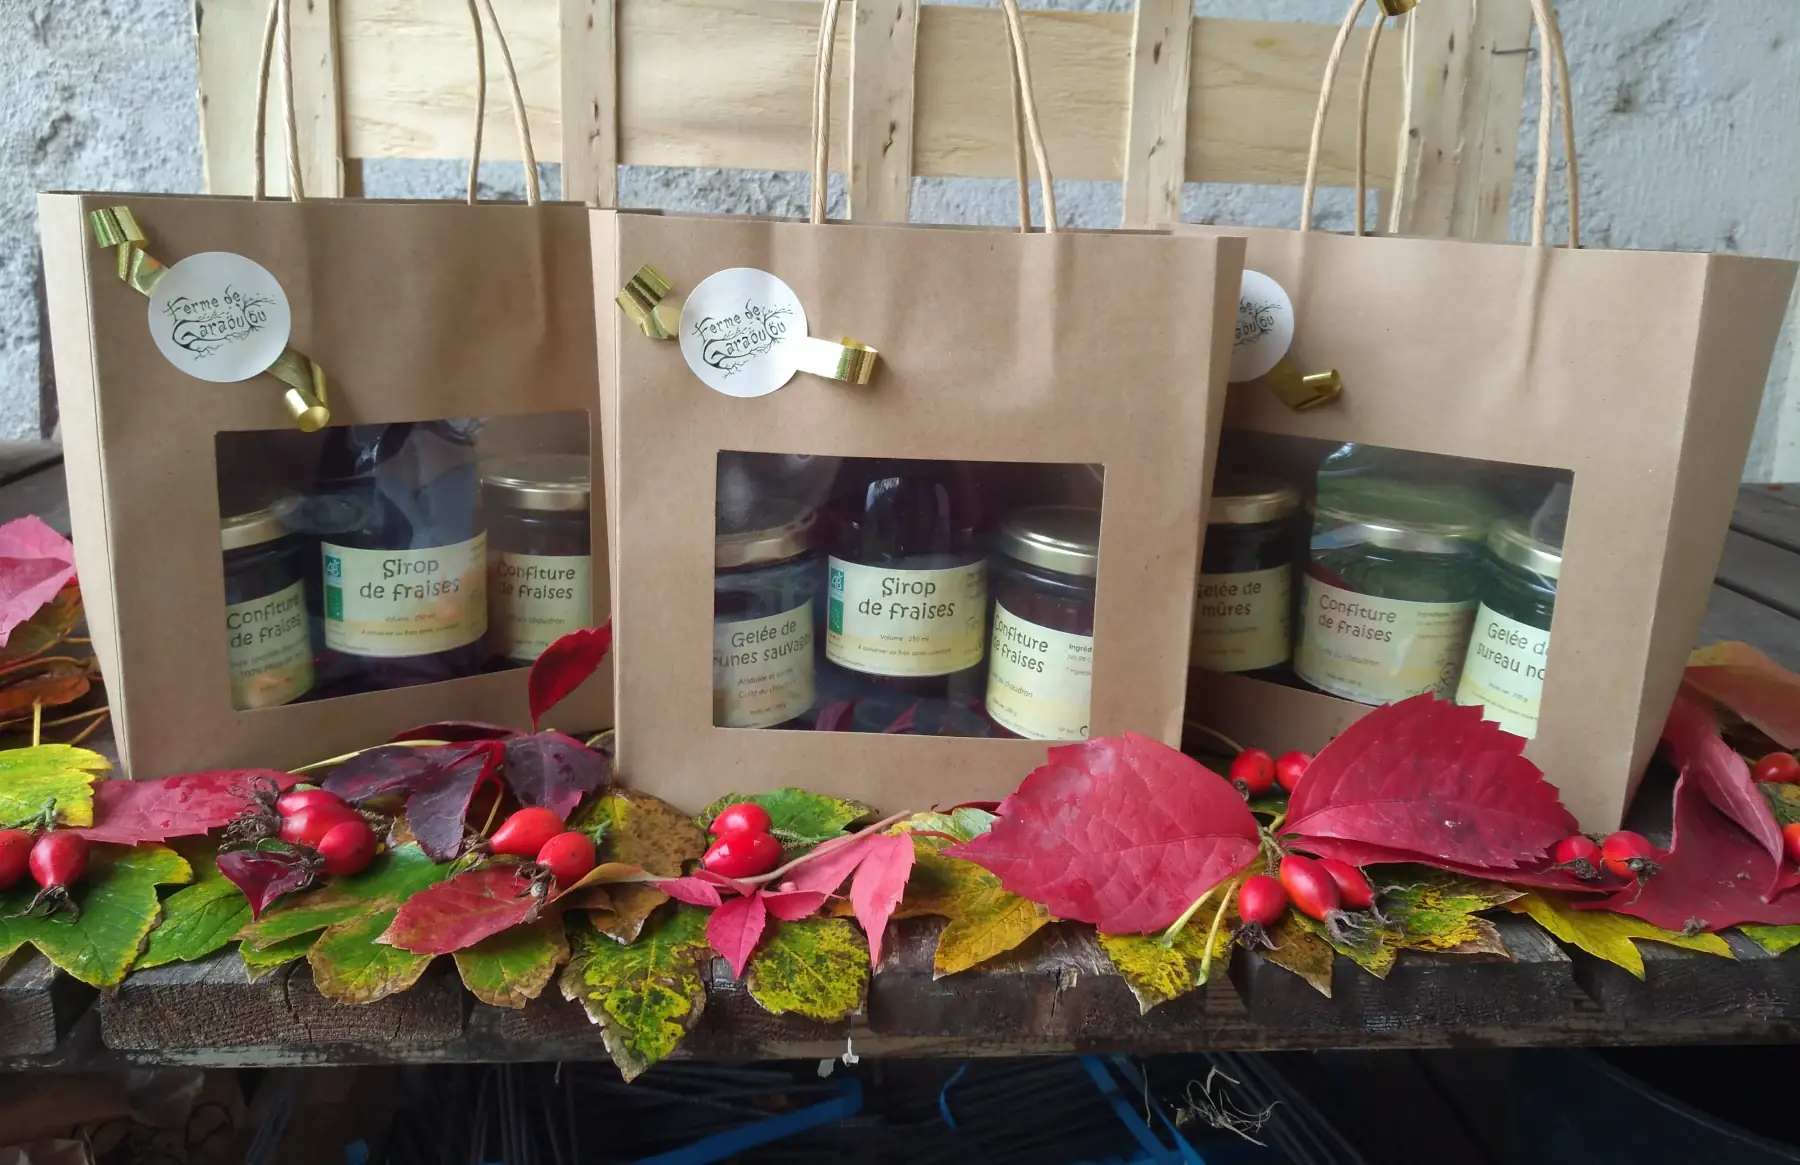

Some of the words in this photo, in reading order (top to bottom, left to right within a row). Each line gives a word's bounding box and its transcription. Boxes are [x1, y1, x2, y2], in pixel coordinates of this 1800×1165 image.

[163, 296, 220, 324] Ferme
[223, 283, 241, 305] de
[692, 316, 741, 344] Ferme
[744, 299, 761, 320] de
[382, 558, 439, 580] Sirop
[498, 560, 576, 581] Confiture
[359, 582, 385, 599] de
[393, 576, 460, 601] fraises
[518, 585, 573, 600] fraises
[882, 576, 936, 598] Sirop
[1243, 581, 1262, 596] de
[226, 593, 300, 630] Confiture
[858, 598, 882, 616] de
[889, 602, 956, 620] fraises
[1202, 601, 1252, 617] mûres
[1319, 594, 1397, 623] Confiture
[230, 633, 254, 648] de
[259, 613, 302, 644] fraises
[731, 624, 777, 648] Gelée
[781, 620, 797, 636] de
[880, 633, 904, 642] Volume
[921, 635, 929, 643] ml
[994, 614, 1049, 653] Confiture
[1318, 614, 1333, 629] de
[1337, 620, 1393, 642] fraises
[1487, 622, 1528, 650] Gelée
[1533, 640, 1548, 656] d
[1001, 643, 1045, 673] fraises
[1477, 642, 1520, 674] sureau
